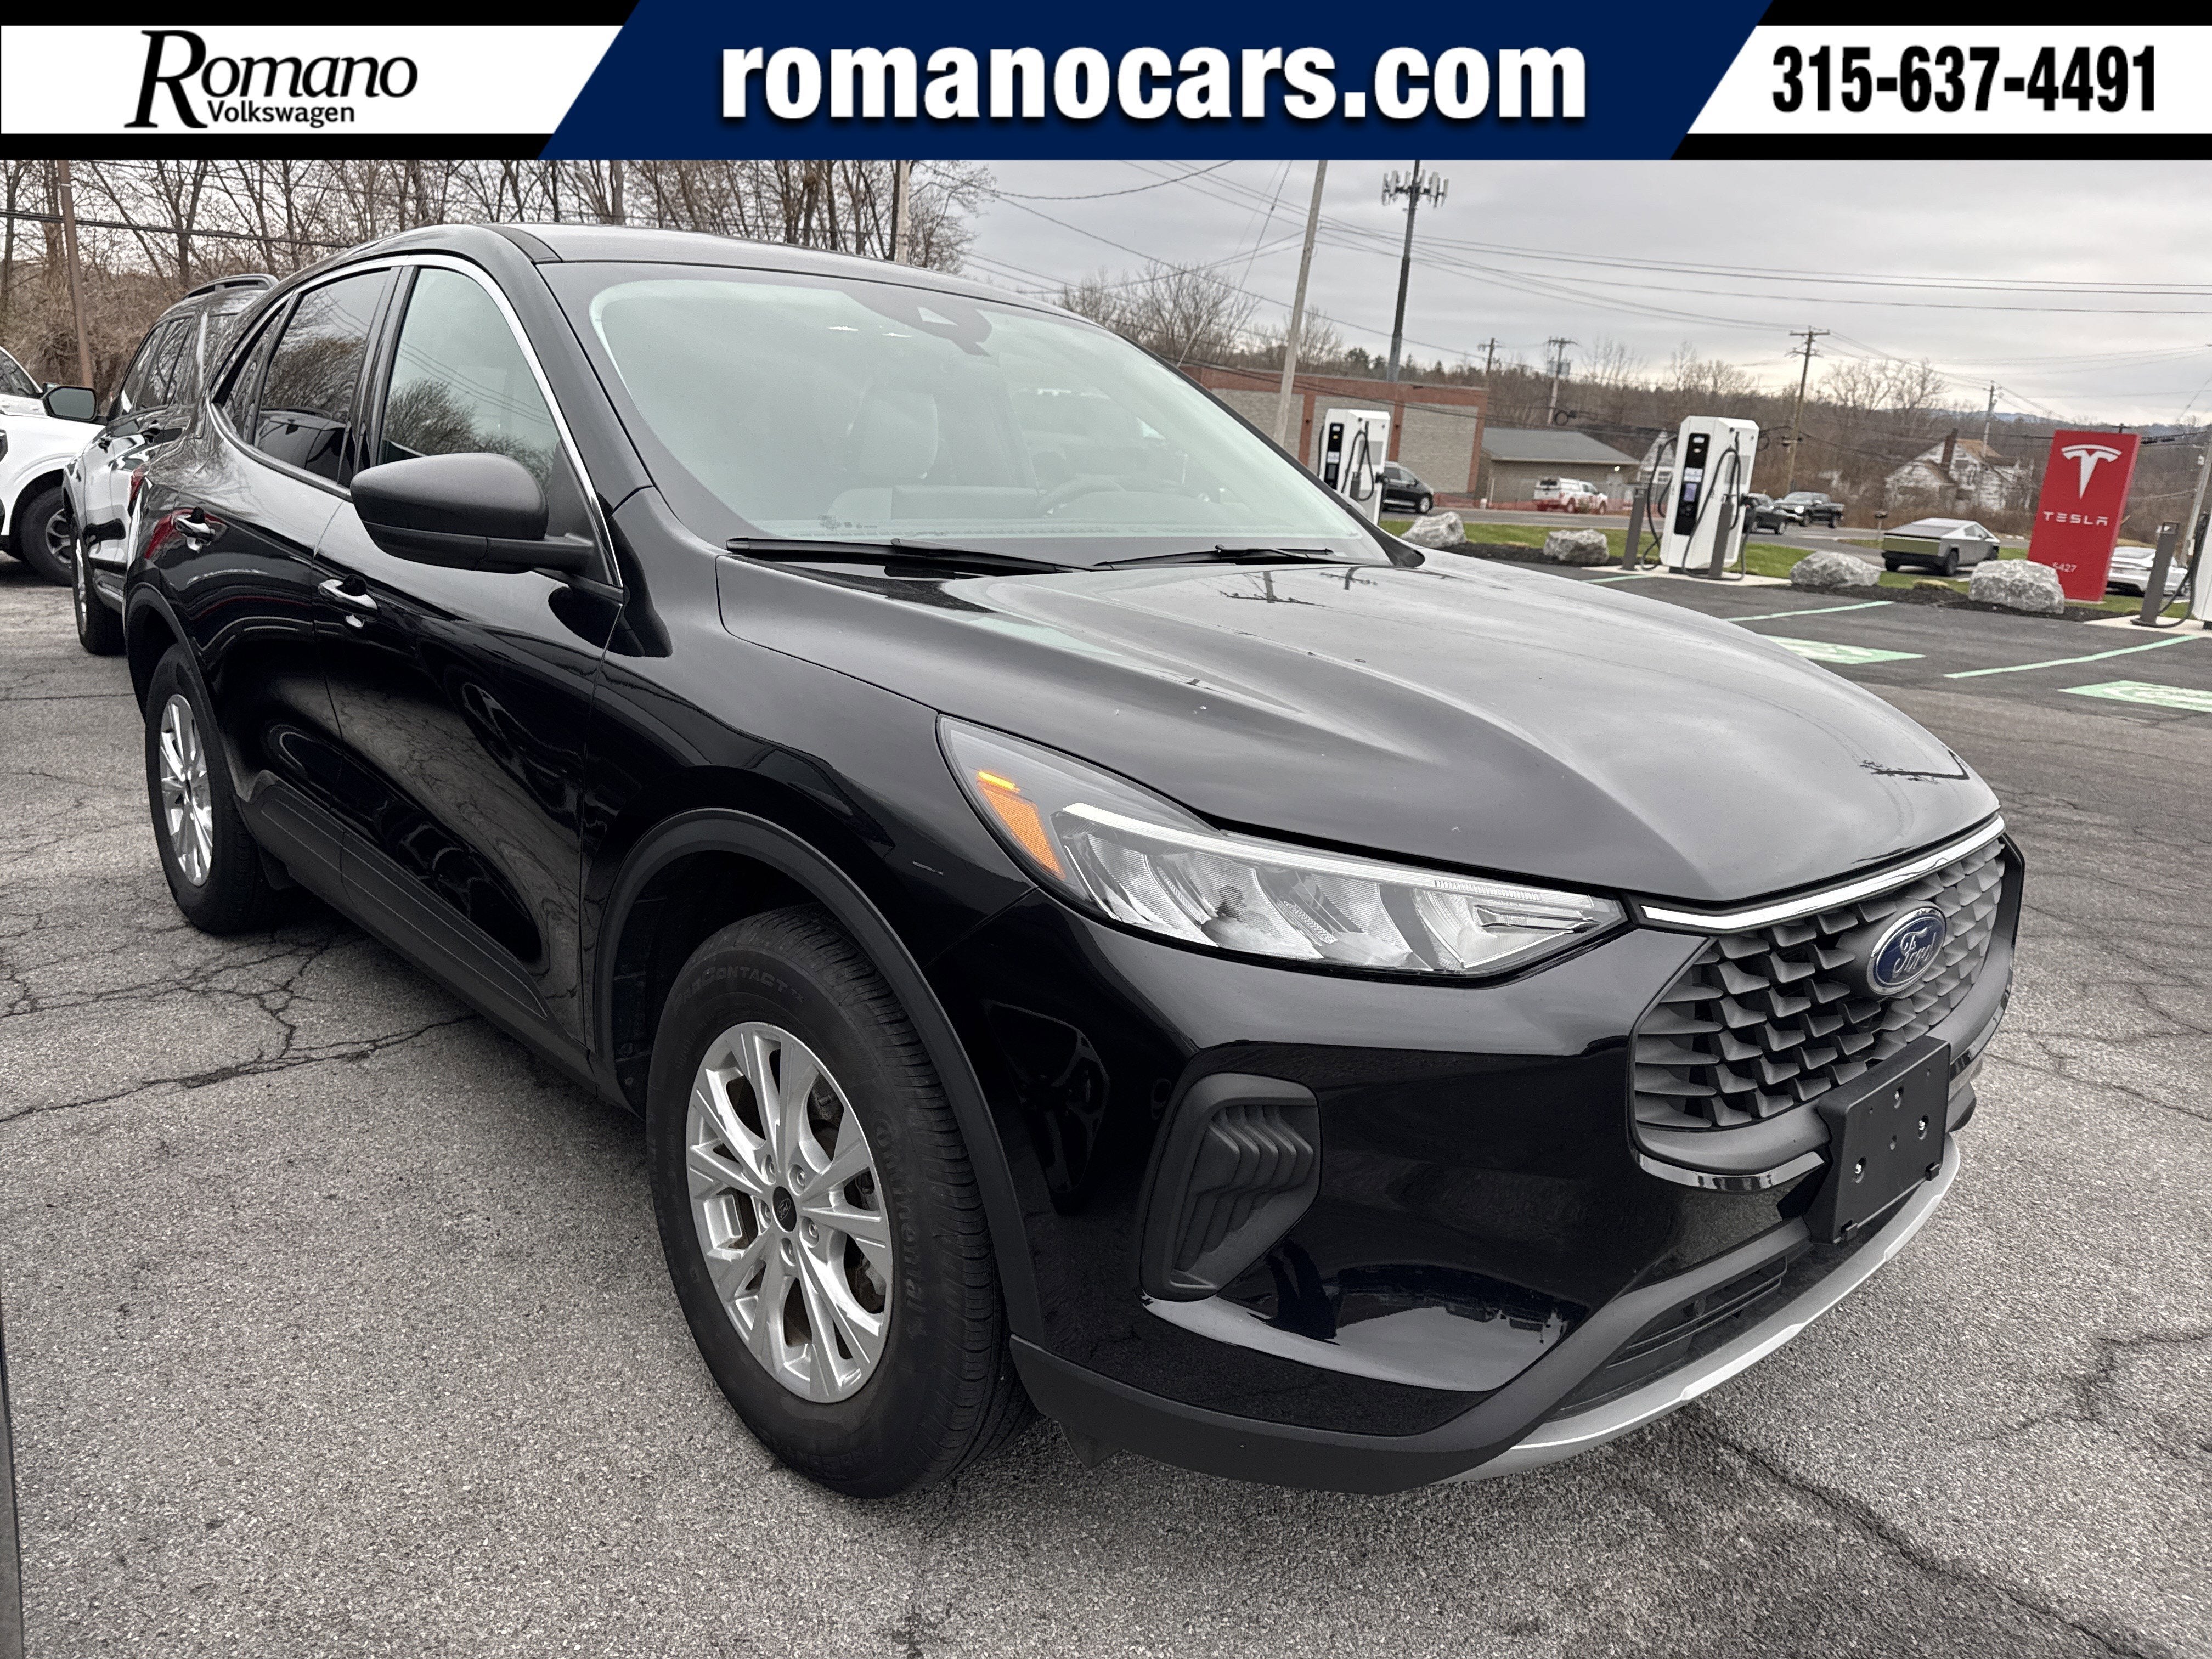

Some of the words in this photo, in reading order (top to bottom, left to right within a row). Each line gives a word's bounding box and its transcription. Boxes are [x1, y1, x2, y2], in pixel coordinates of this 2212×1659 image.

[2043, 511, 2109, 526] TESLA
[1893, 926, 1937, 978] Ford
[871, 1110, 926, 1314] Continental
